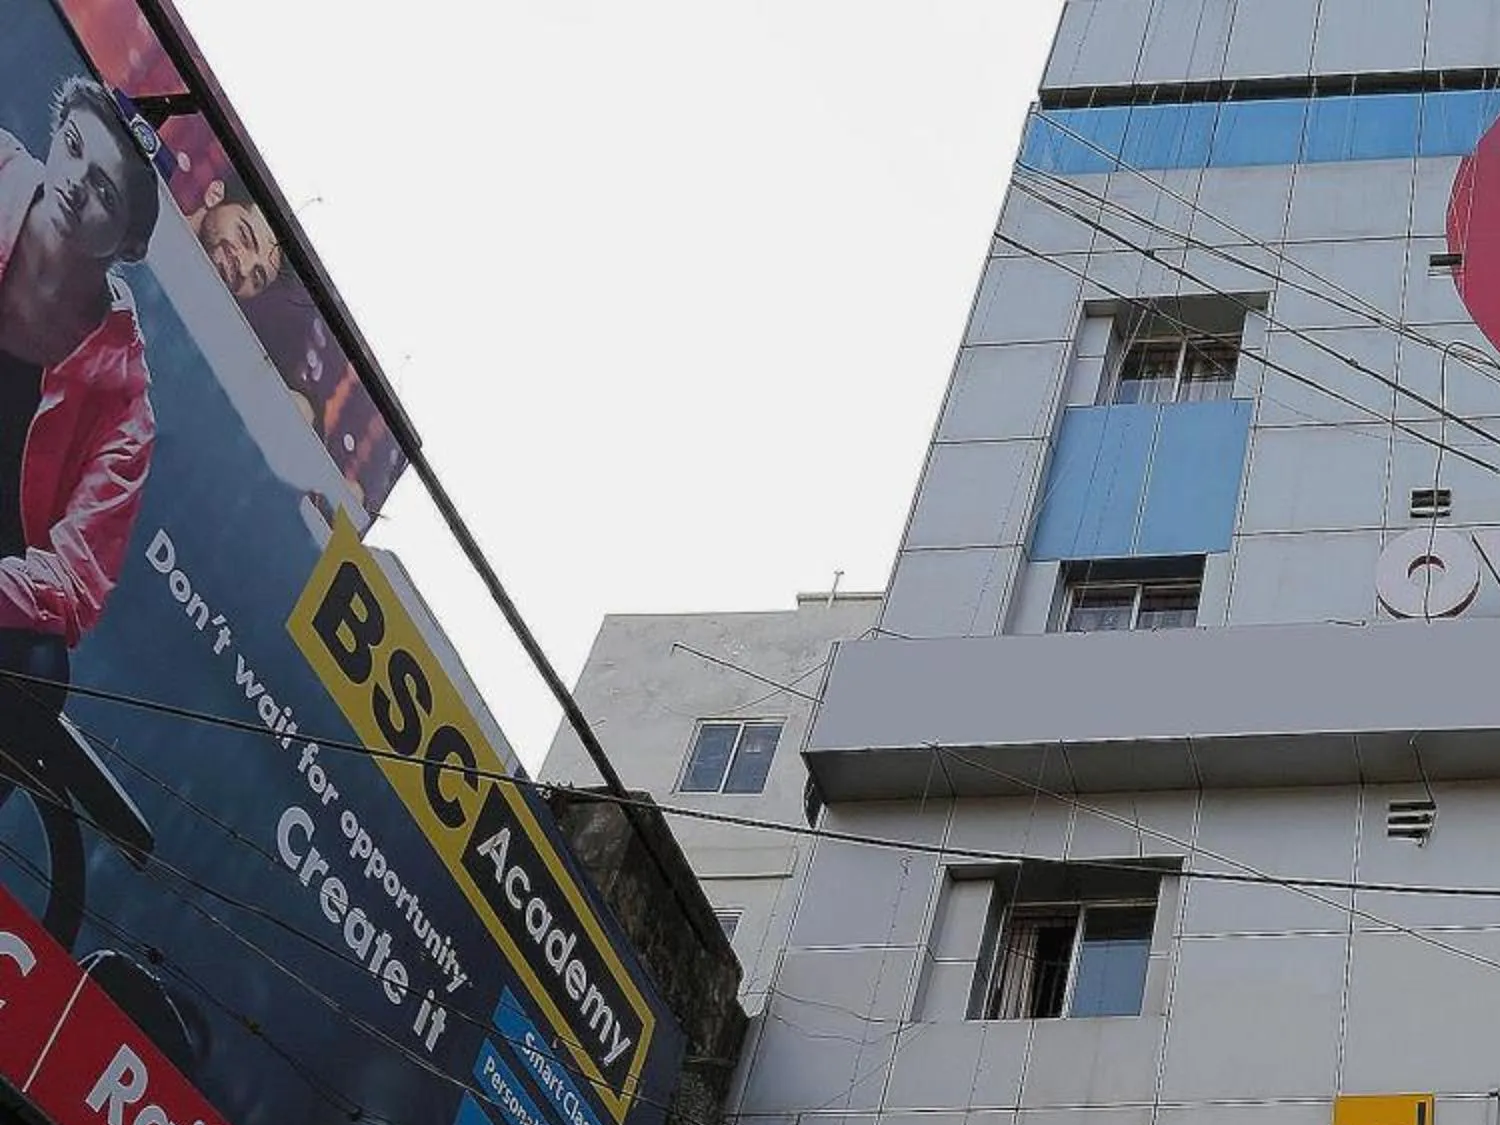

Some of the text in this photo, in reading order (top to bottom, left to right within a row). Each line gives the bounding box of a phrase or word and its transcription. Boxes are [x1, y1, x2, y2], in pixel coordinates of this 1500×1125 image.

[145, 528, 471, 994] Don't wait for opportunity
[276, 805, 447, 1053] Create it
[312, 560, 632, 1067] BSC Academy
[521, 1031, 563, 1101] Smart
